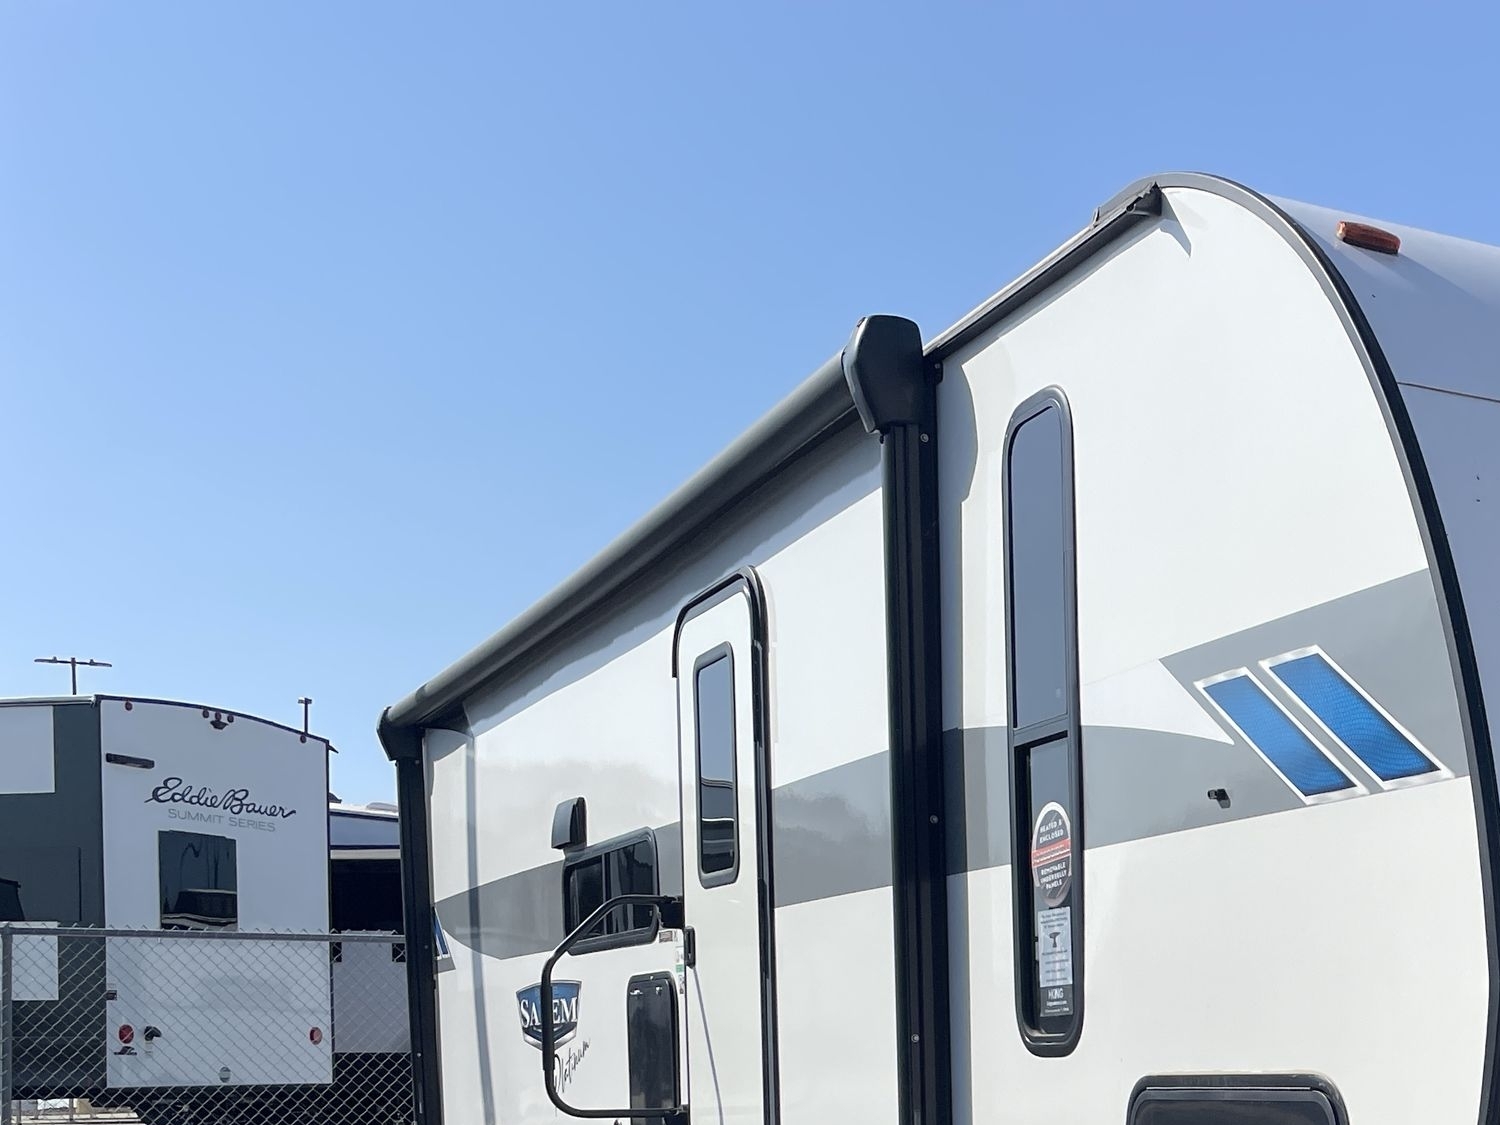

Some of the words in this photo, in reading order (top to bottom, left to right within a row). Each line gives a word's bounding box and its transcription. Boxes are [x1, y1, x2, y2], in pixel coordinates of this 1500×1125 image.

[144, 776, 221, 809] Eddie
[222, 788, 296, 819] Bauer
[167, 808, 224, 825] SUMMIT
[228, 816, 276, 832] SERIES
[520, 997, 578, 1028] SAEM
